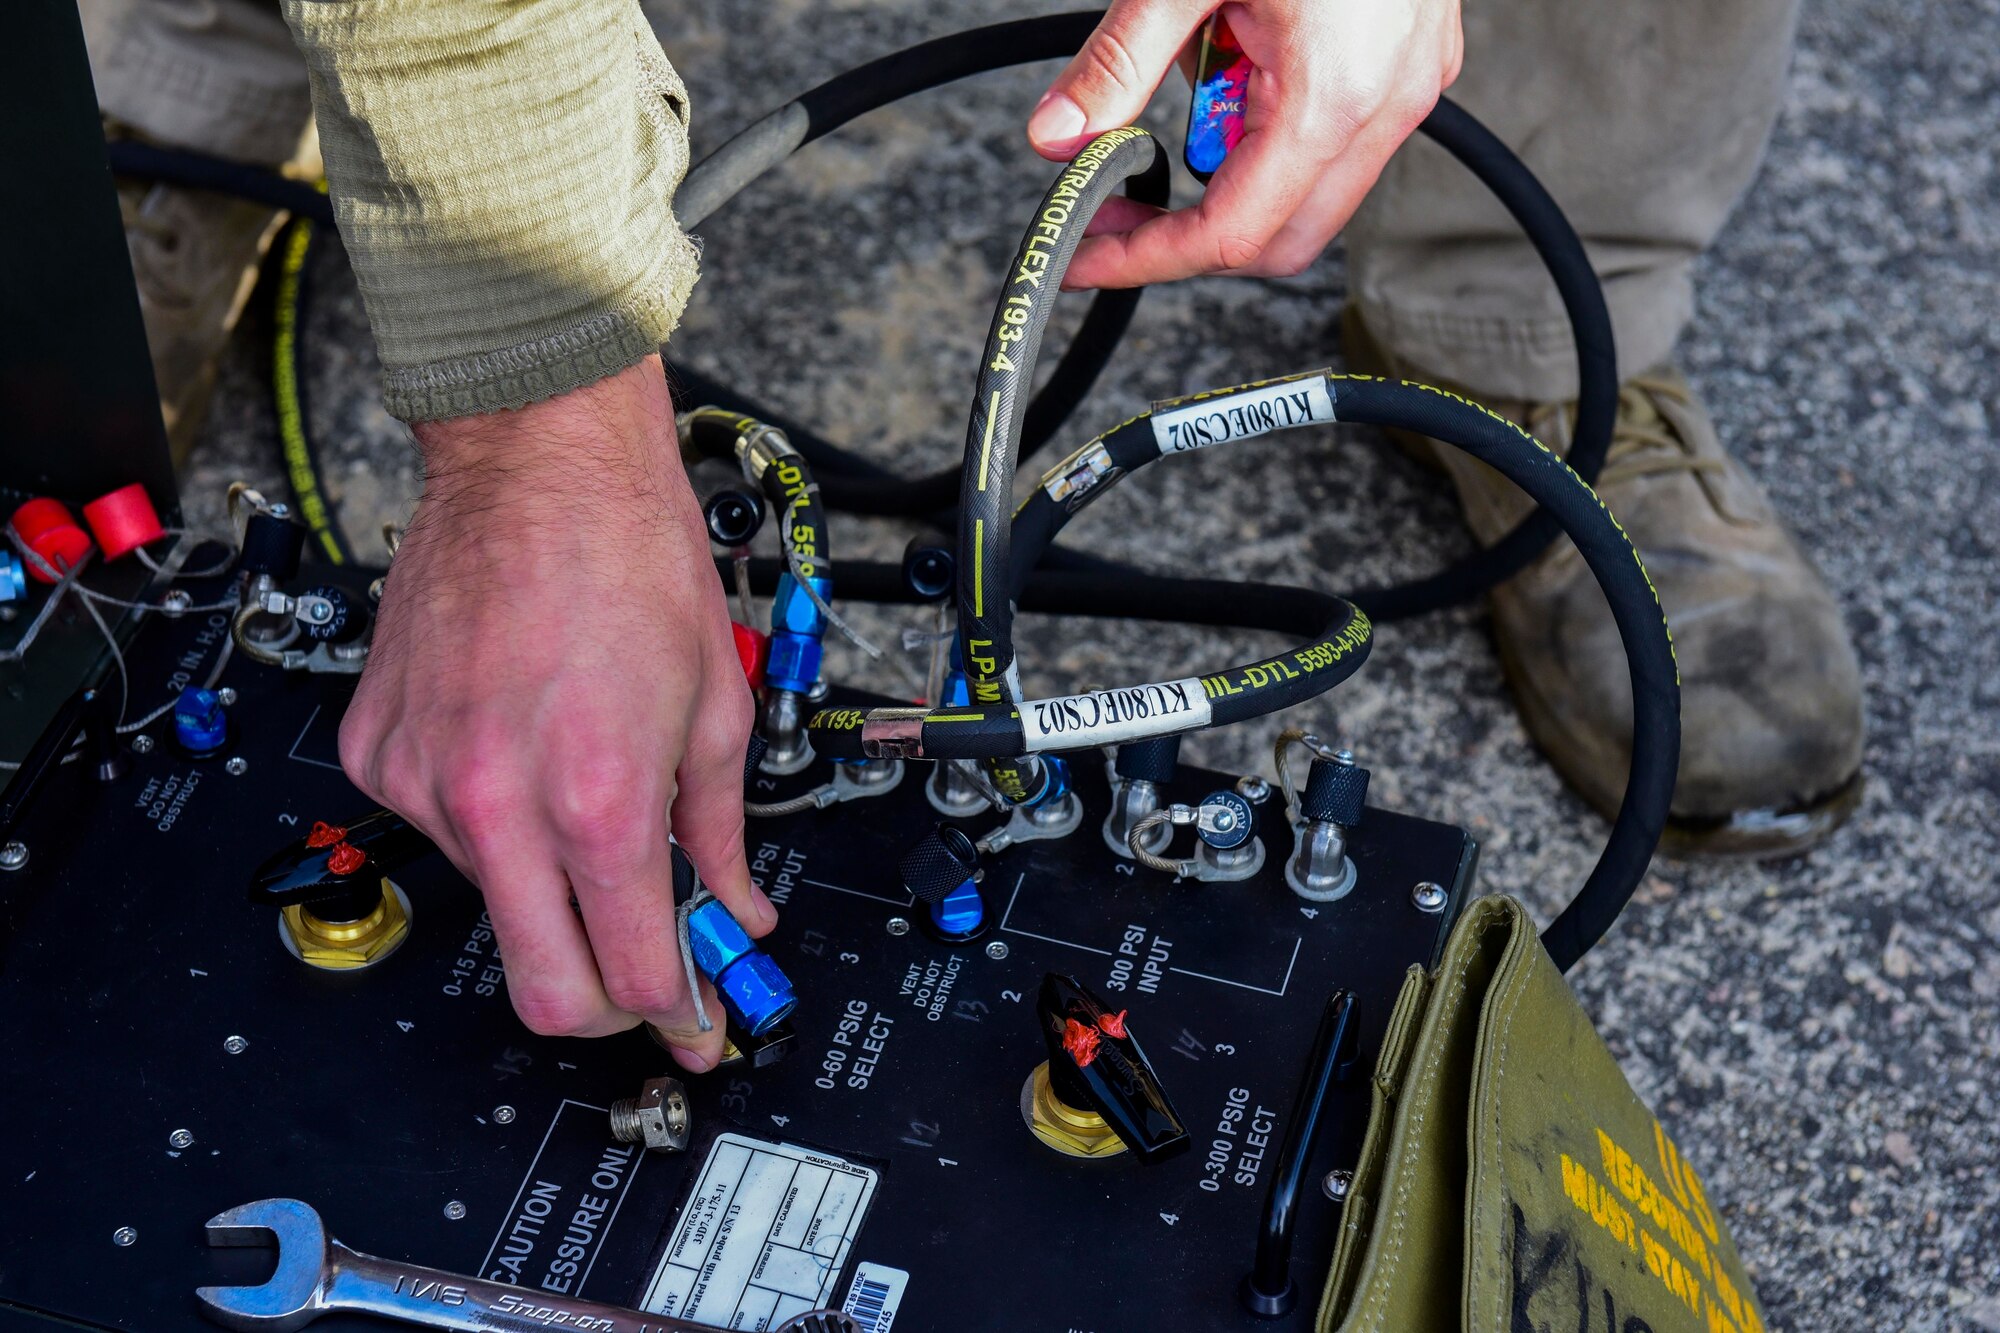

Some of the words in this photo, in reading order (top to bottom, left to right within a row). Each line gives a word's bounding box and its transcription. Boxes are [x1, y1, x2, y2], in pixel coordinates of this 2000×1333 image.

[1210, 101, 1245, 112] SMO
[991, 295, 1034, 373] 193-4
[1167, 390, 1314, 451] KU80ECS02
[167, 671, 190, 692] 20
[180, 650, 204, 669] IN.
[1035, 681, 1195, 733] KU80ECS02
[134, 776, 162, 808] VENT
[147, 794, 166, 819] DO
[161, 773, 182, 798] NOT
[157, 770, 203, 832] OBSTRUCT
[279, 812, 298, 826] 2
[752, 842, 781, 873] PSI
[768, 849, 807, 904] INPUT
[1115, 863, 1135, 877] 2
[1300, 906, 1319, 920] 4
[1119, 924, 1147, 953] PSI
[189, 968, 208, 978] 1
[442, 953, 474, 996] 0-15
[839, 952, 860, 965] 3
[1107, 957, 1134, 992] 300
[1137, 935, 1173, 994] INPUT
[900, 962, 923, 996] VENT
[914, 991, 928, 1008] DO
[921, 960, 943, 991] NOT
[927, 954, 963, 1021] OBSTRUCT
[1002, 989, 1023, 1004] 2
[396, 1020, 414, 1033] 4
[815, 1049, 847, 1090] 0-60
[833, 999, 868, 1046] PSIG
[559, 1061, 578, 1071] 1
[848, 1012, 895, 1090] SELECT
[1215, 1043, 1236, 1056] 3
[770, 1112, 790, 1128] 4
[1199, 1134, 1233, 1193] 0-300
[1217, 1087, 1250, 1136] PSIG
[1234, 1105, 1277, 1187] SELECT
[938, 1155, 959, 1169] 1
[541, 1192, 608, 1294] ESSURE
[592, 1143, 636, 1192] ONL
[693, 1183, 727, 1245] 33D7-3-175-11
[773, 1220, 784, 1237] DATE
[780, 1187, 799, 1221] CALIBRATED
[1159, 1212, 1180, 1226] 4
[490, 1180, 562, 1285] CAUTION
[674, 1226, 693, 1258] AUTHORITY
[807, 1229, 818, 1246] DATE
[813, 1217, 823, 1231] DUE
[1560, 1153, 1638, 1255] MUST
[1640, 1228, 1700, 1320] STAY
[684, 1283, 707, 1320] librated
[702, 1261, 717, 1282] with
[712, 1234, 728, 1262] probe
[722, 1217, 736, 1234] S/N
[731, 1204, 741, 1215] 13
[755, 1252, 770, 1279] CERTIFIED
[767, 1244, 774, 1253] BY
[853, 1271, 866, 1294] TMDE
[393, 1274, 469, 1307] 11/16
[488, 1294, 615, 1333] Snap-on
